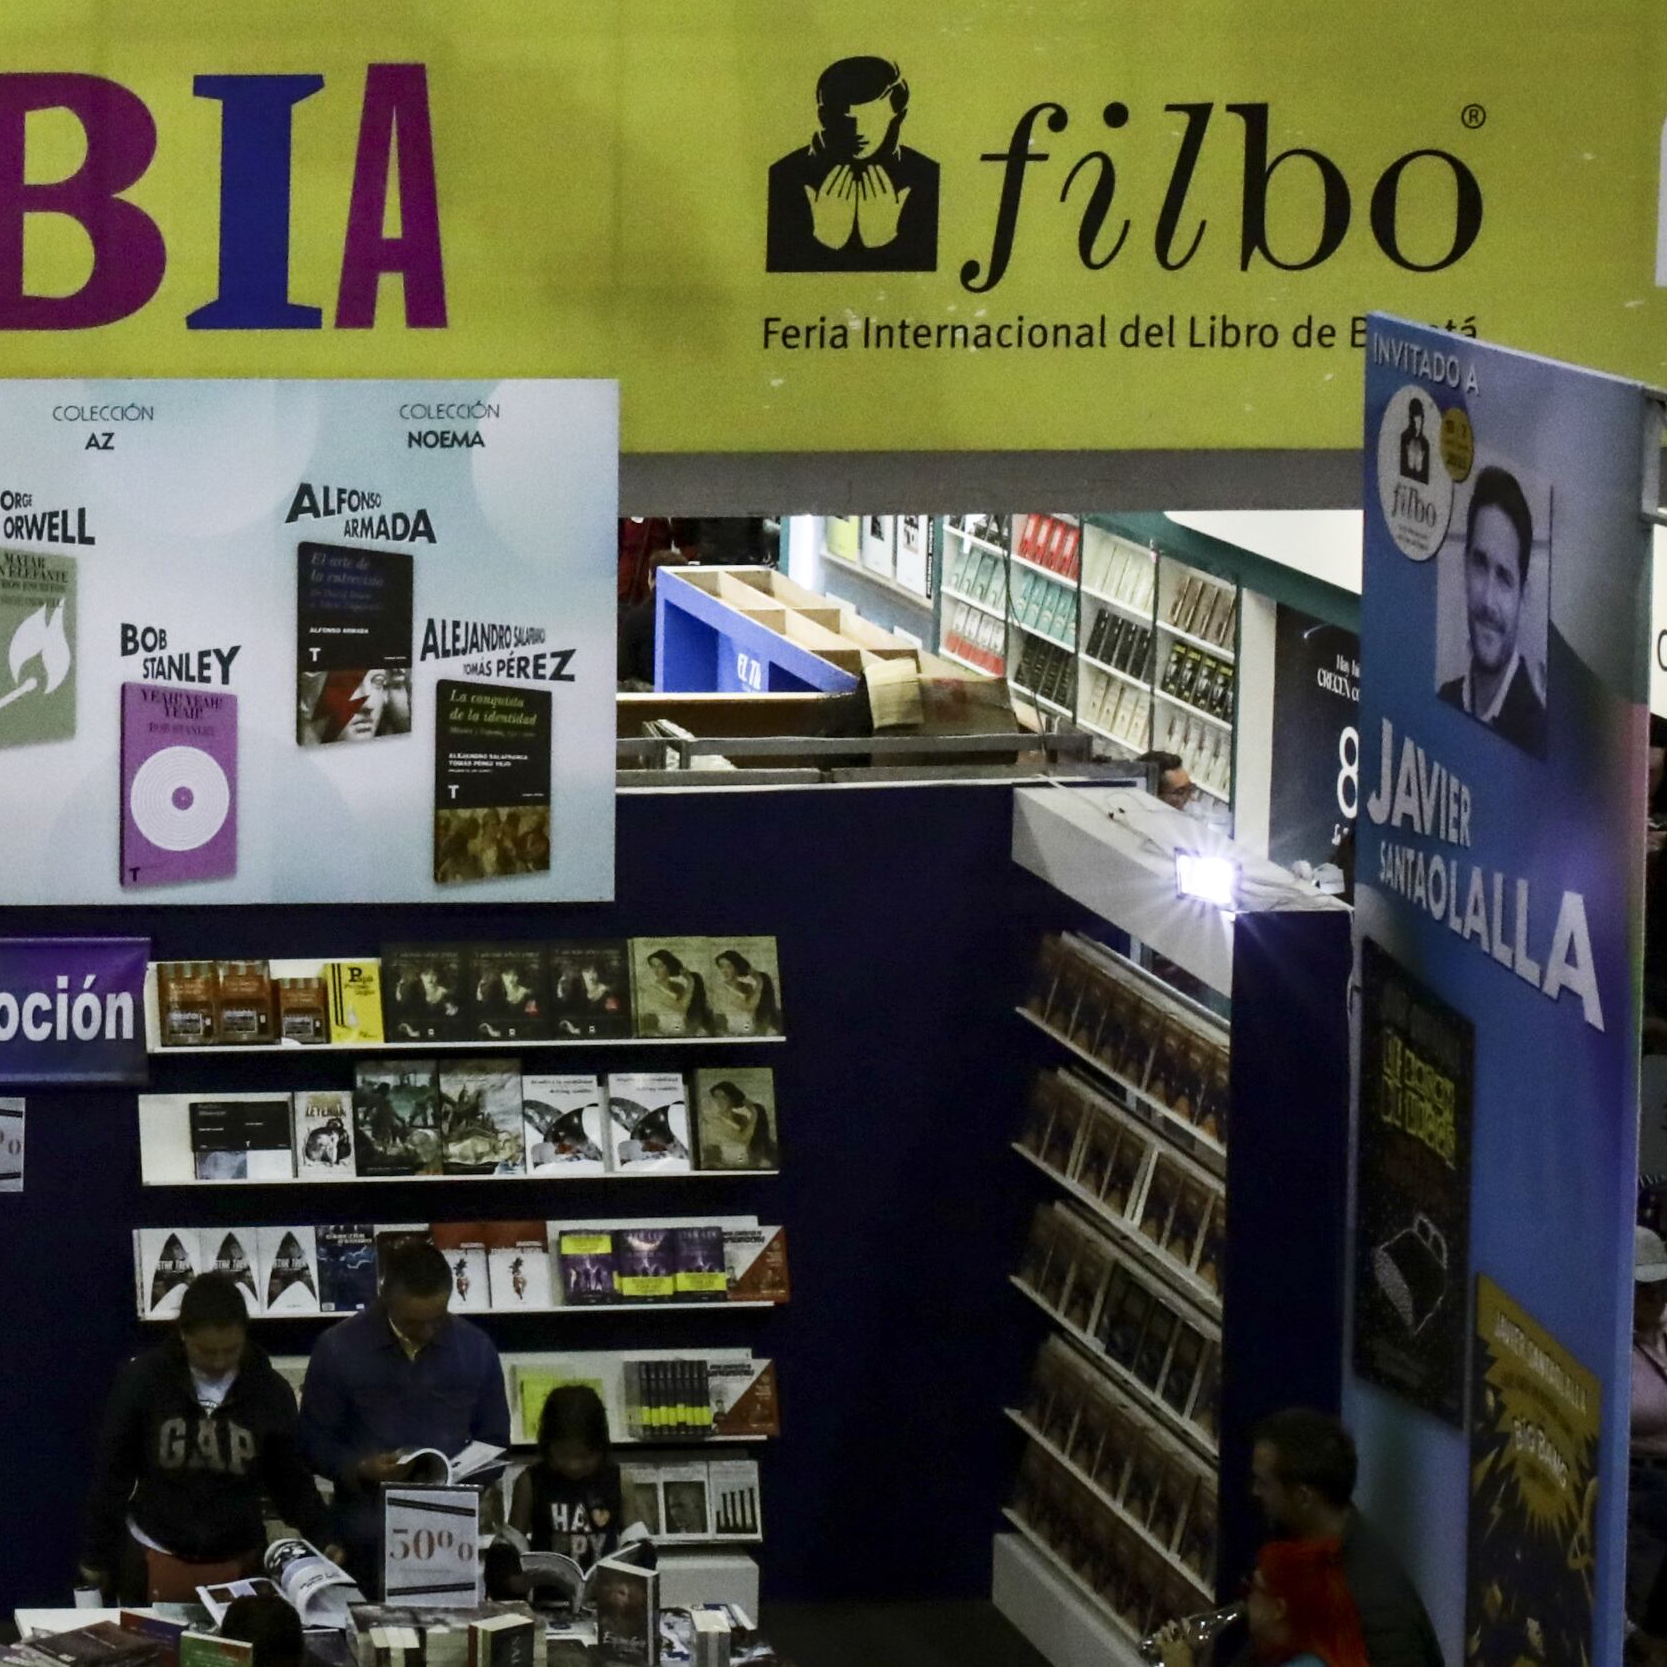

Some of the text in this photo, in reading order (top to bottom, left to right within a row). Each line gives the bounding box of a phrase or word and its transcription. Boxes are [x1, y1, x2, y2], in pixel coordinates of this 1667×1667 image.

[958, 100, 1485, 295] filbo
[763, 314, 851, 351] Feria
[862, 314, 1110, 351] Internacional
[1119, 314, 1178, 351] del
[1187, 314, 1278, 351] Libro
[1292, 314, 1338, 351] de
[1373, 332, 1480, 397] INVITADO A
[52, 402, 154, 423] COLECCIÓN
[399, 400, 501, 420] COLECCIÓN
[84, 432, 116, 451] AZ
[407, 430, 486, 449] NOEMA
[284, 482, 383, 525] ALFONSO
[1391, 483, 1437, 528] filbo
[3, 506, 96, 546] ORWELL
[343, 508, 438, 545] ARMADA
[120, 622, 168, 657] BOB
[308, 647, 322, 662] T
[420, 617, 512, 662] ALEJANDRO
[142, 645, 242, 686] STANLEY
[463, 650, 577, 683] TOMÁS PÉREZ
[1367, 717, 1472, 848] JAVIER
[1379, 838, 1606, 1034] SANTAOLALLA
[159, 1418, 258, 1475] GAP
[389, 1526, 474, 1563] 50%
